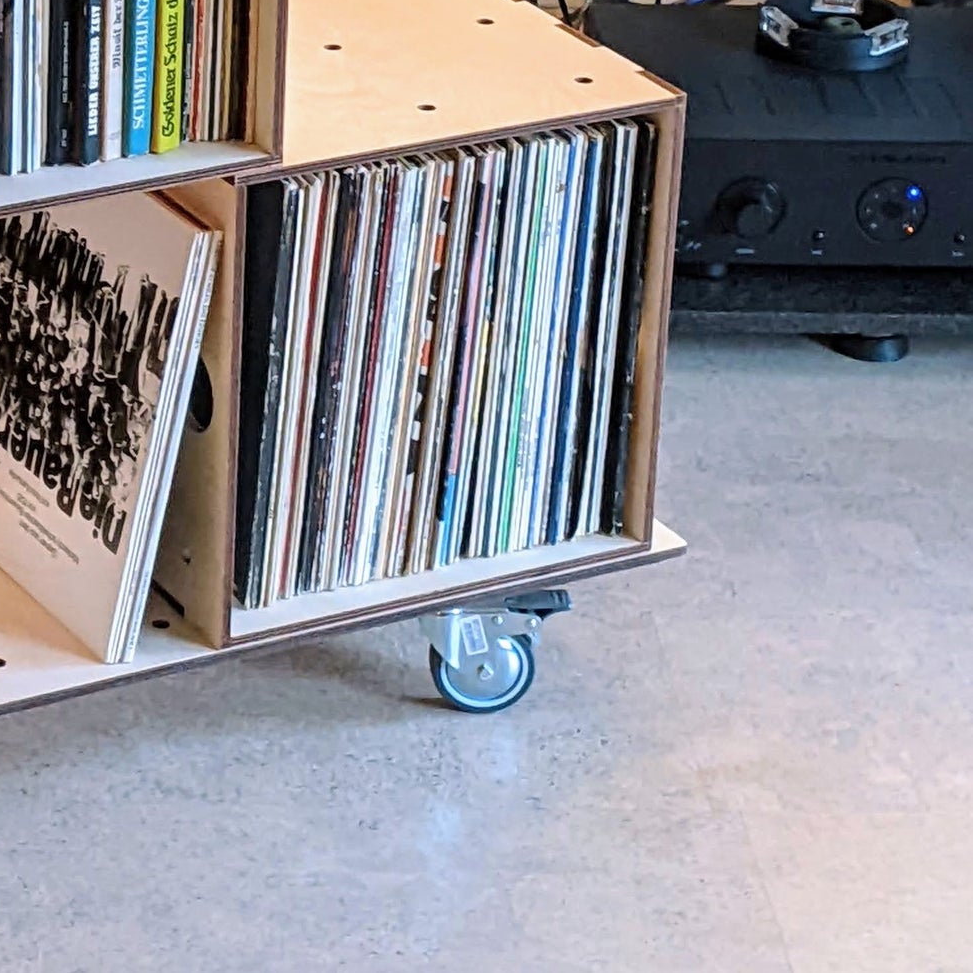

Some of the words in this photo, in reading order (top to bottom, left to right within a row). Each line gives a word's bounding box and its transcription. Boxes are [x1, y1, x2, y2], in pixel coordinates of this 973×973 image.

[90, 5, 102, 33] ZEIT
[163, 12, 179, 66] Schatz
[161, 68, 177, 138] Goldener
